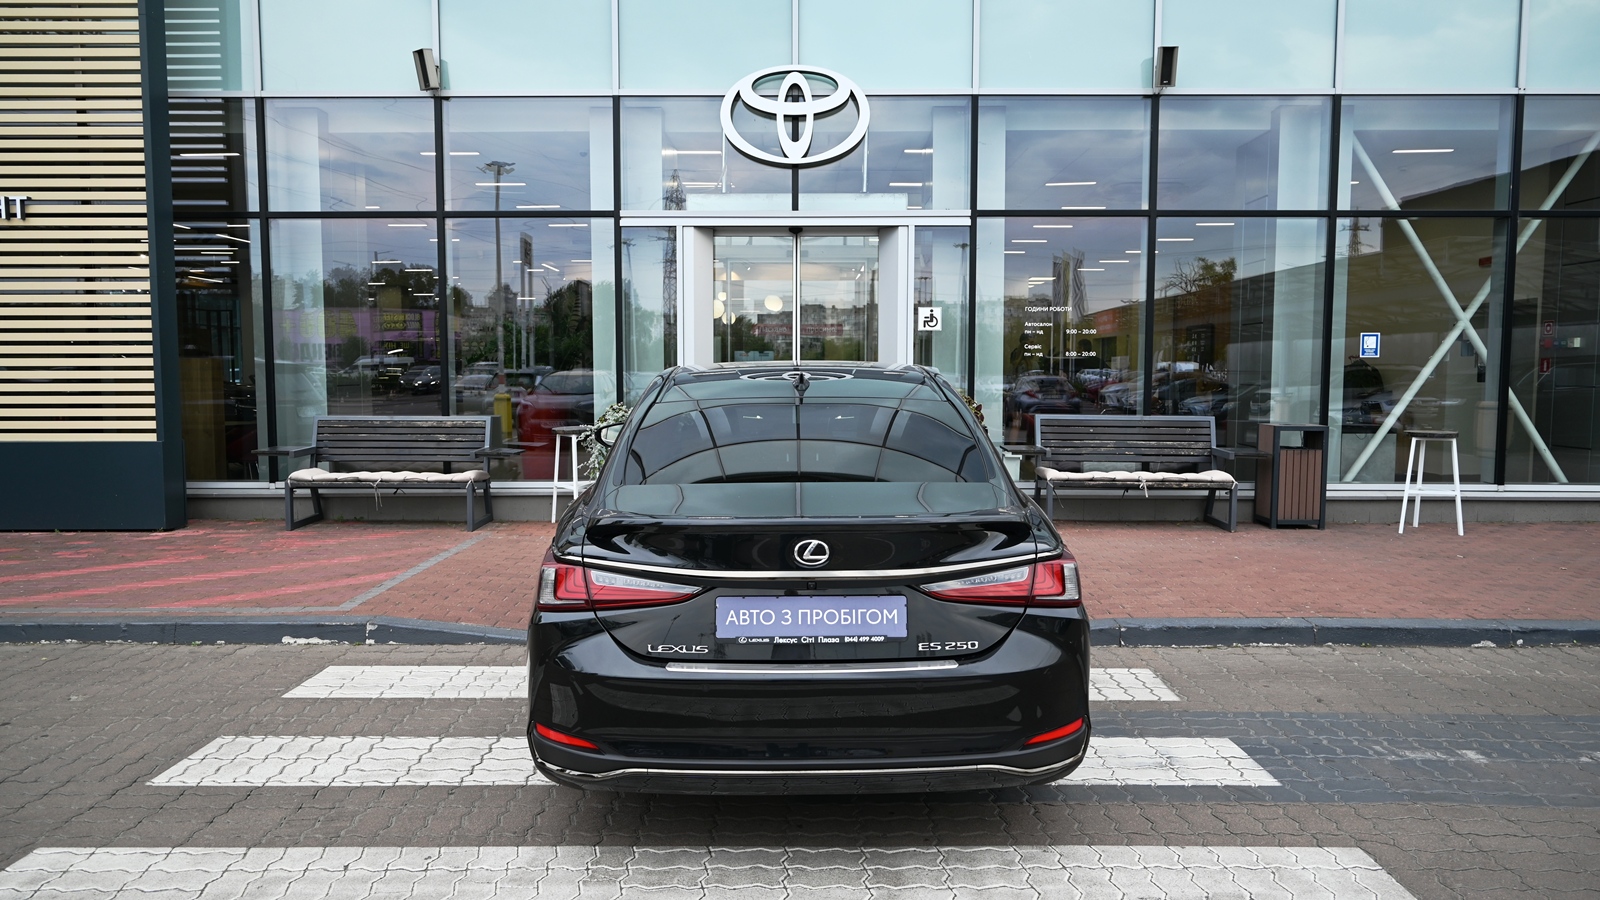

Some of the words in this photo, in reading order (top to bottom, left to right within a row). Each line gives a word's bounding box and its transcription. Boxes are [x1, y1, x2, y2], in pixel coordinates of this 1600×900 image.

[725, 609, 775, 625] АВТО
[798, 608, 898, 625] ПРОБІГОМ
[773, 636, 798, 644] Лексус
[918, 642, 942, 651] ES
[944, 640, 979, 650] 250
[647, 643, 709, 654] LEXUS
